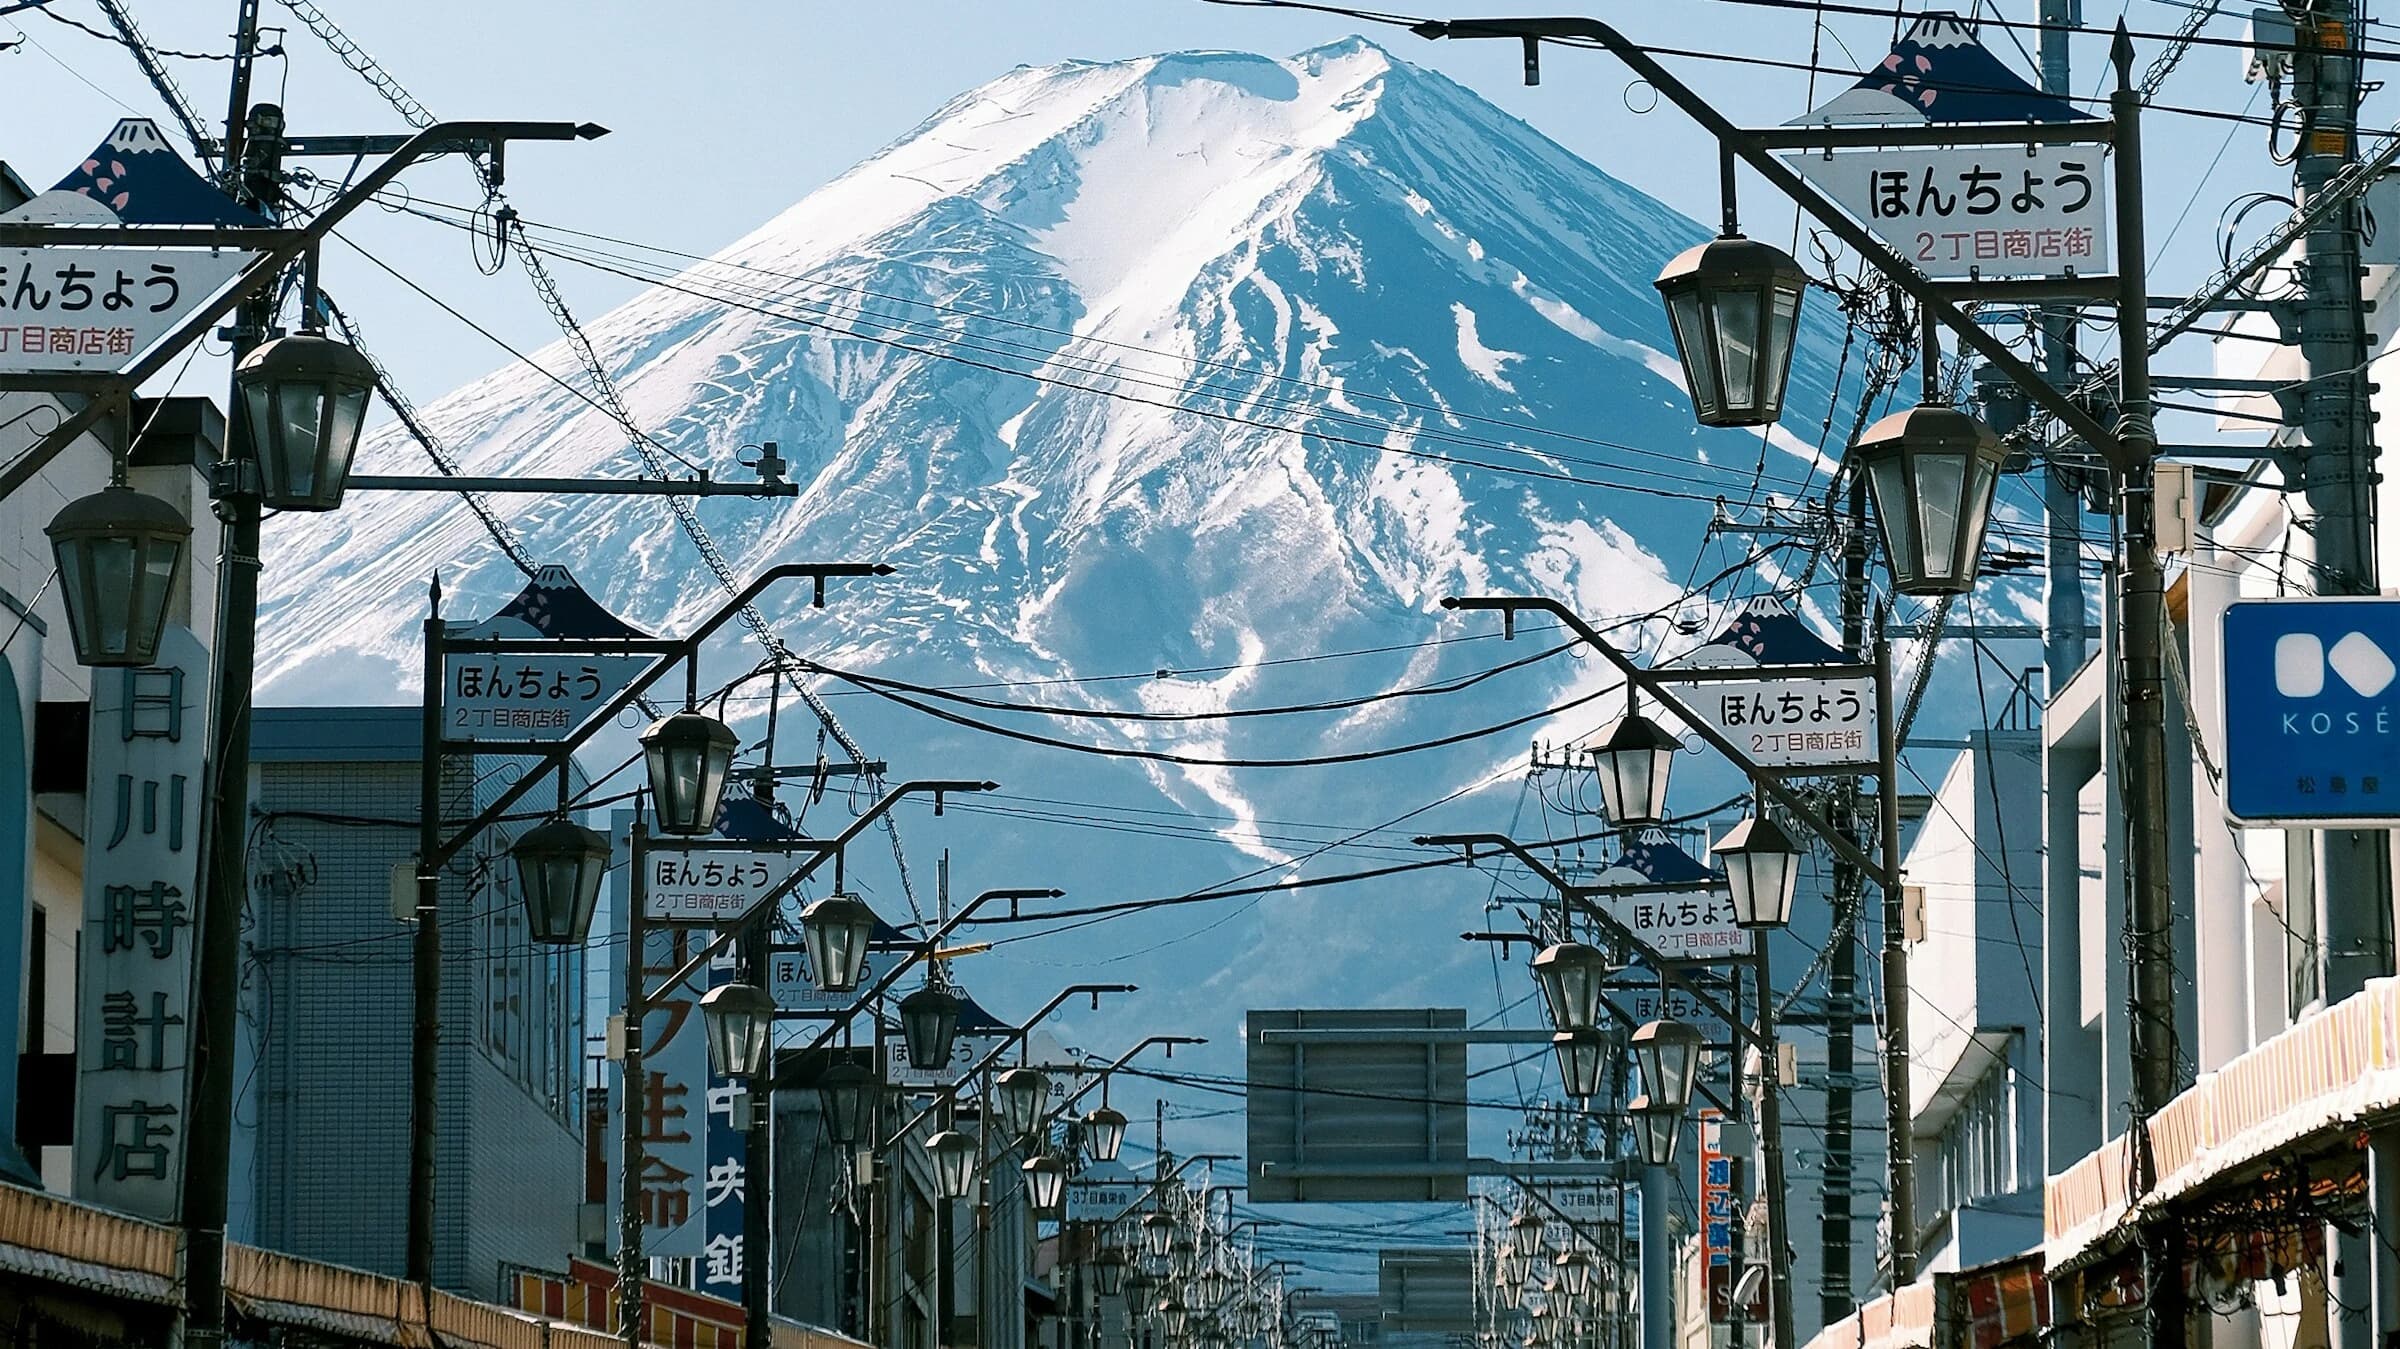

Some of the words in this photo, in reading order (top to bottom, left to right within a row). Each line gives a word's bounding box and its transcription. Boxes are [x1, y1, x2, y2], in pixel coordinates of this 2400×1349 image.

[1870, 161, 2092, 219] ほんちょう
[1916, 227, 2093, 262] 2丁目商店街
[0, 262, 179, 313] んちょう
[457, 664, 601, 701] ほんちょう
[455, 707, 570, 729] 2丁目商店街
[1720, 689, 1861, 726] ほんちょう
[2282, 705, 2390, 735] KOSÉ
[1751, 730, 1862, 753] 2丁目商店街
[656, 859, 769, 889] ほんちょう
[655, 893, 745, 910] 2丁目商店街
[93, 665, 187, 1186] 日川時計店
[1657, 930, 1742, 949] 2丁目商店街
[776, 960, 872, 982] ほんう
